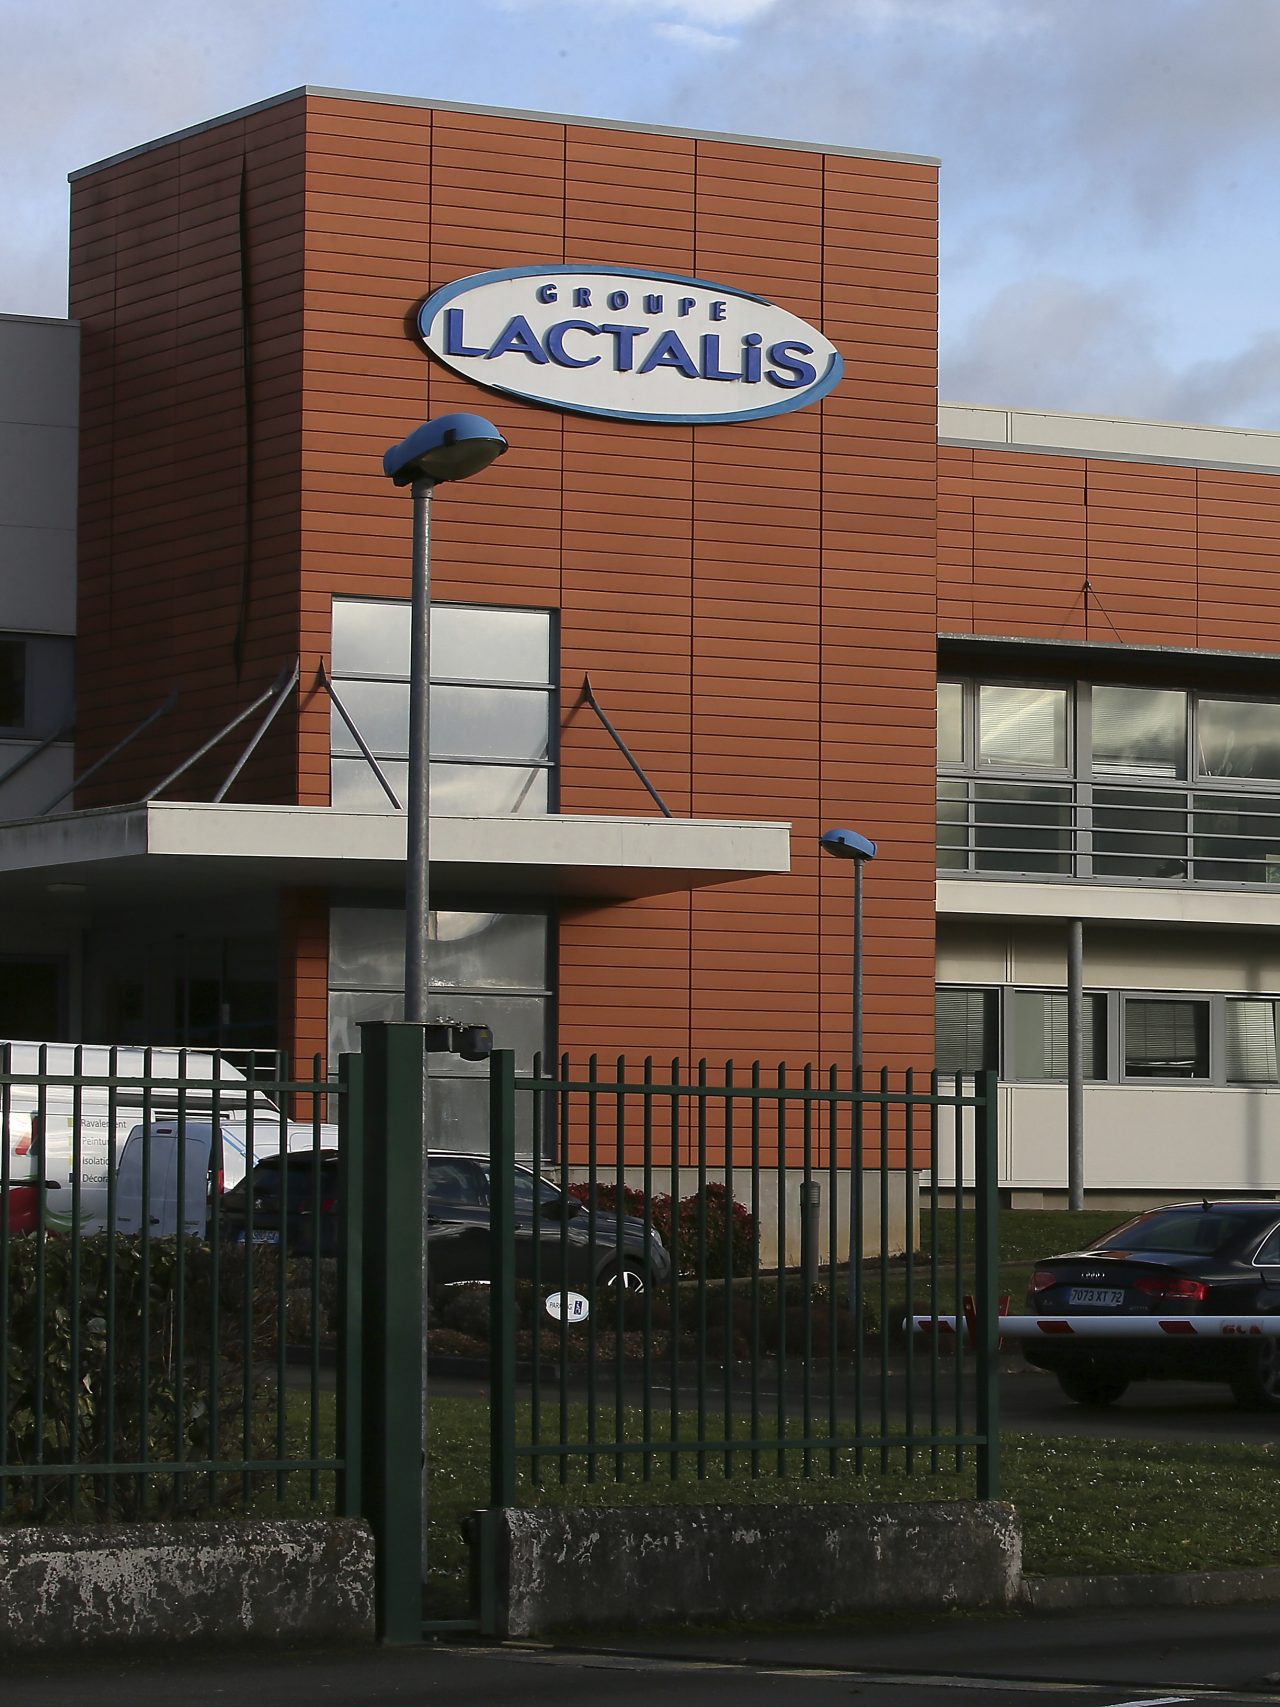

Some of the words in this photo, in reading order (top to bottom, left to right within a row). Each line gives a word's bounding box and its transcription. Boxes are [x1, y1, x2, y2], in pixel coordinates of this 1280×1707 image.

[536, 283, 728, 321] GROUPE
[81, 1119, 127, 1129] Ravaleent
[82, 1136, 109, 1146] Peintu
[82, 1156, 109, 1166] Isolatio
[82, 1173, 109, 1183] Décora
[1072, 1289, 1094, 1302] 7073
[1110, 1291, 1123, 1303] 72
